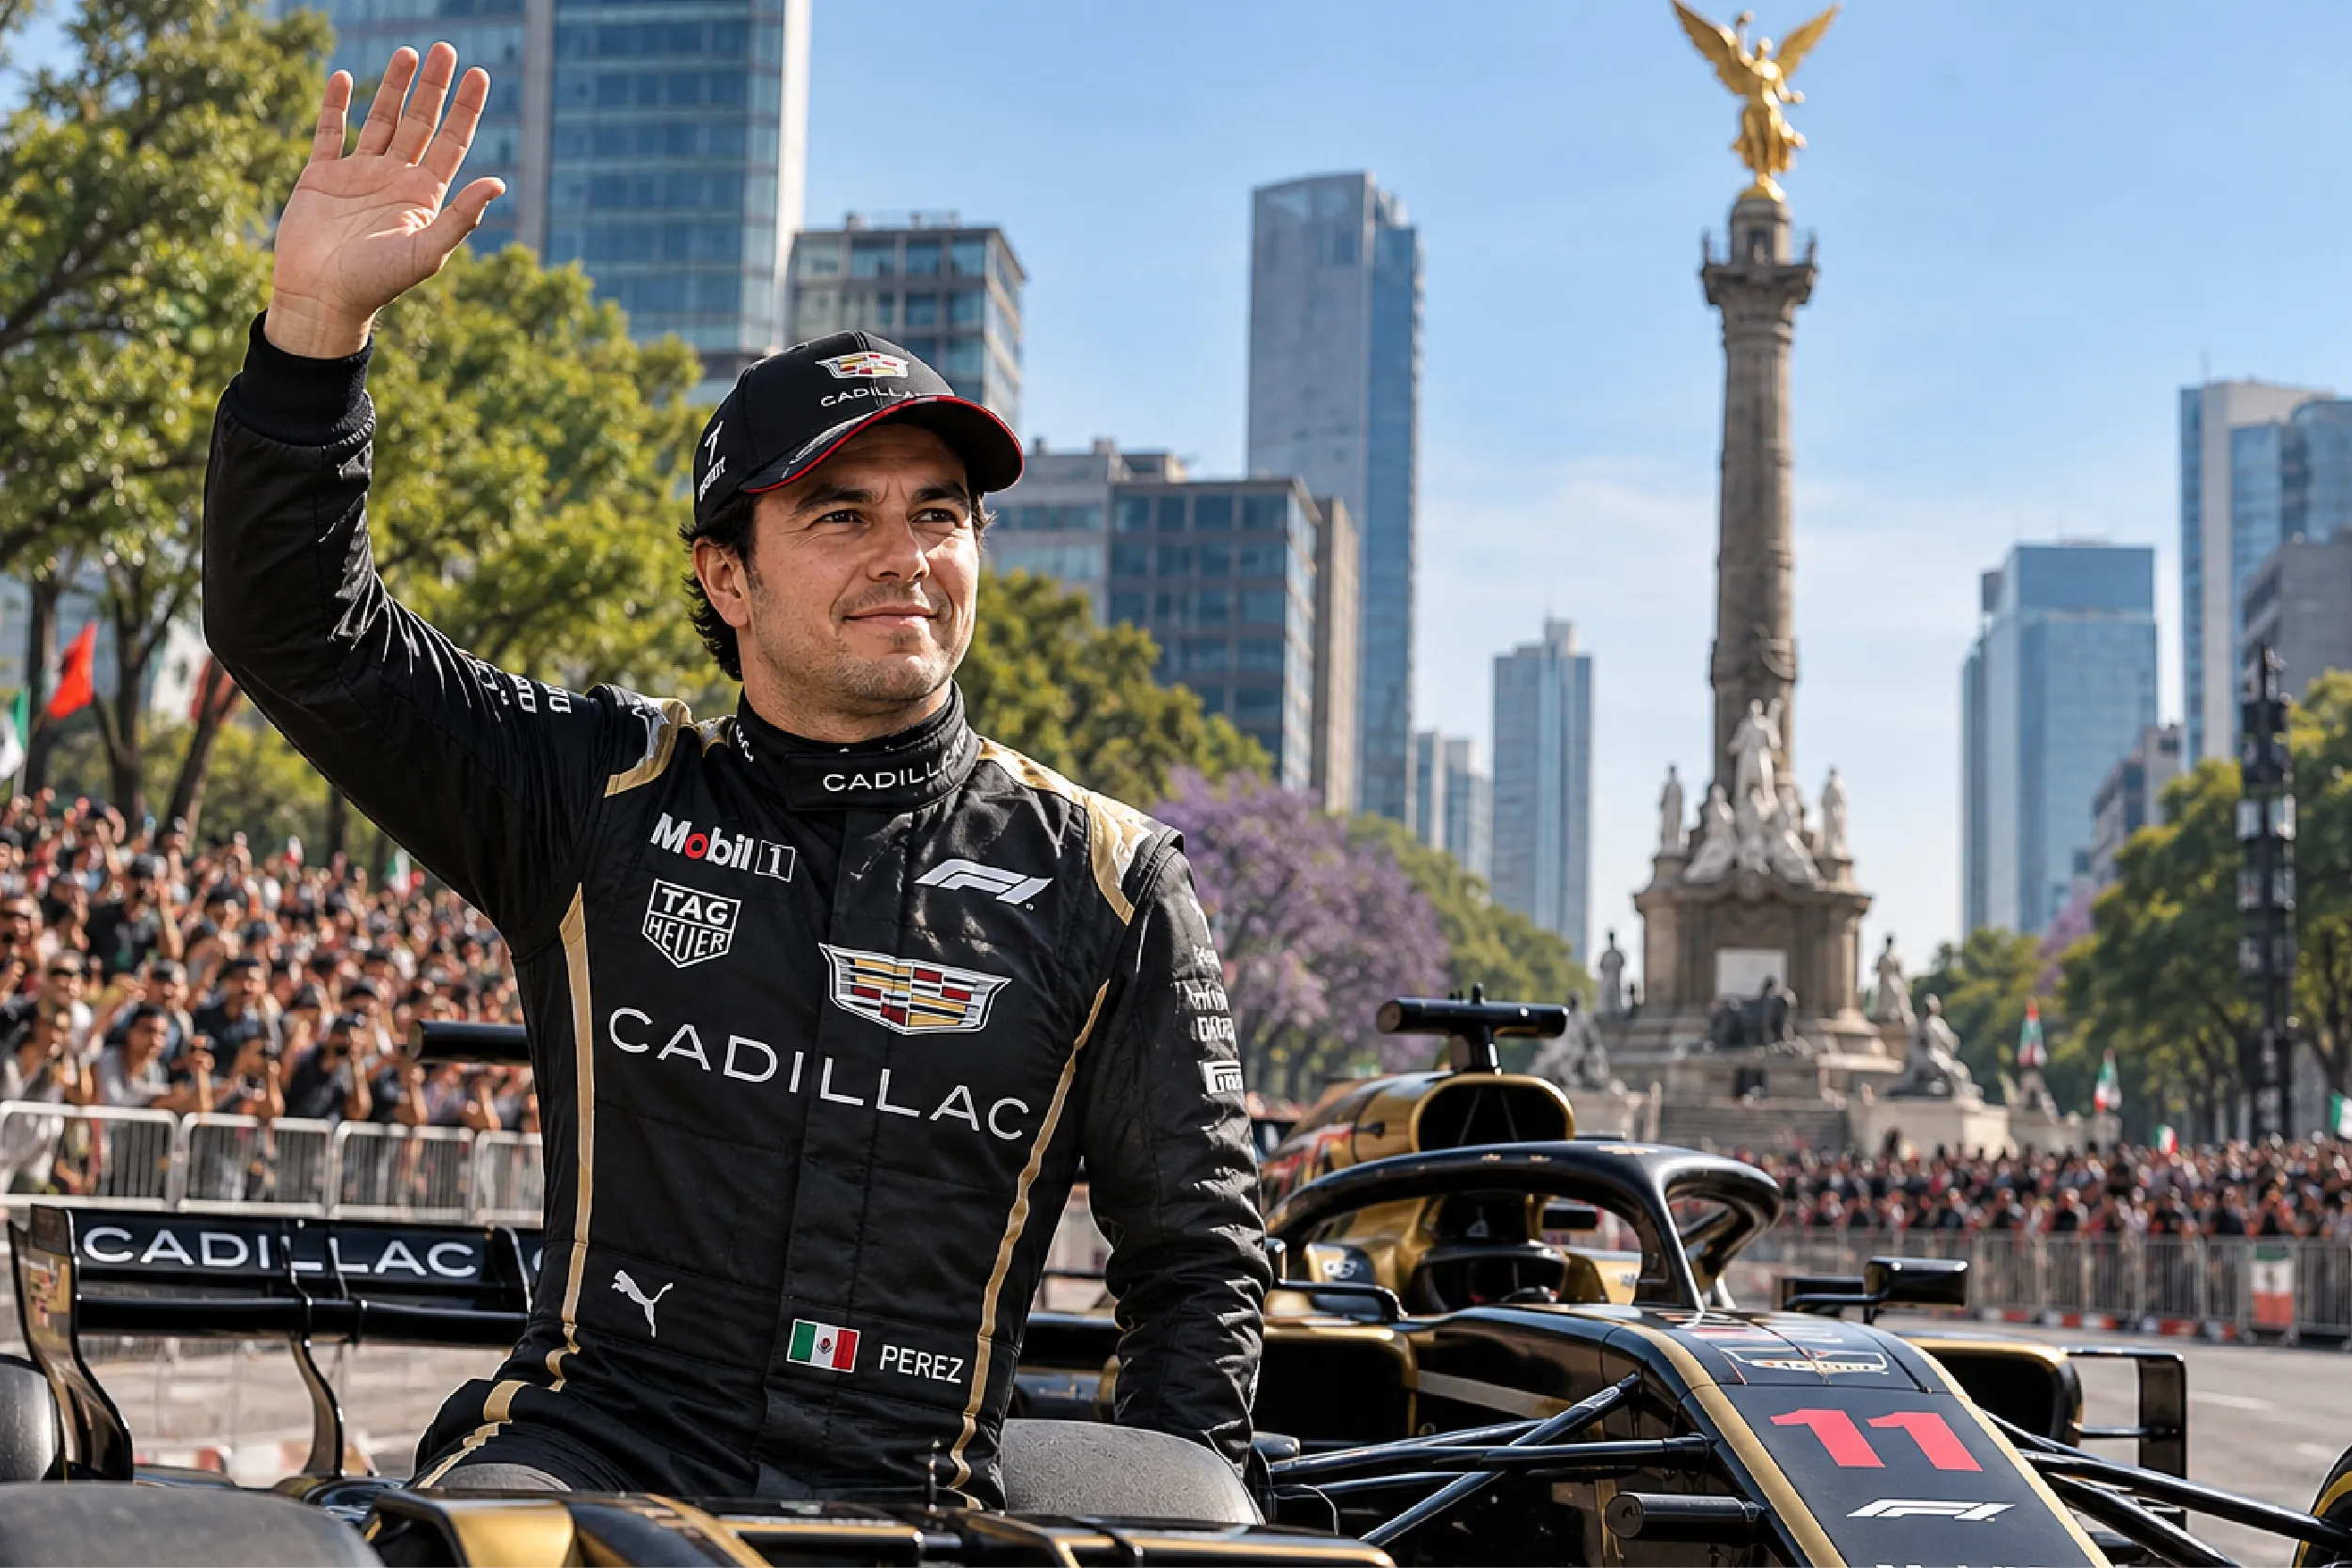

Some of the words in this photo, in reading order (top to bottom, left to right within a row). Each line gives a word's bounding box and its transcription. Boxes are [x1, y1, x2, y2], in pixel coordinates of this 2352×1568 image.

[820, 385, 922, 407] CADILLA
[649, 812, 755, 871] Mobil
[661, 887, 729, 926] TAG
[648, 916, 726, 962] HEUER
[608, 1006, 1030, 1140] CADILLAC
[83, 1227, 477, 1277] CADILLAC
[879, 1343, 964, 1384] PEREZ
[1770, 1408, 1983, 1472] 11
